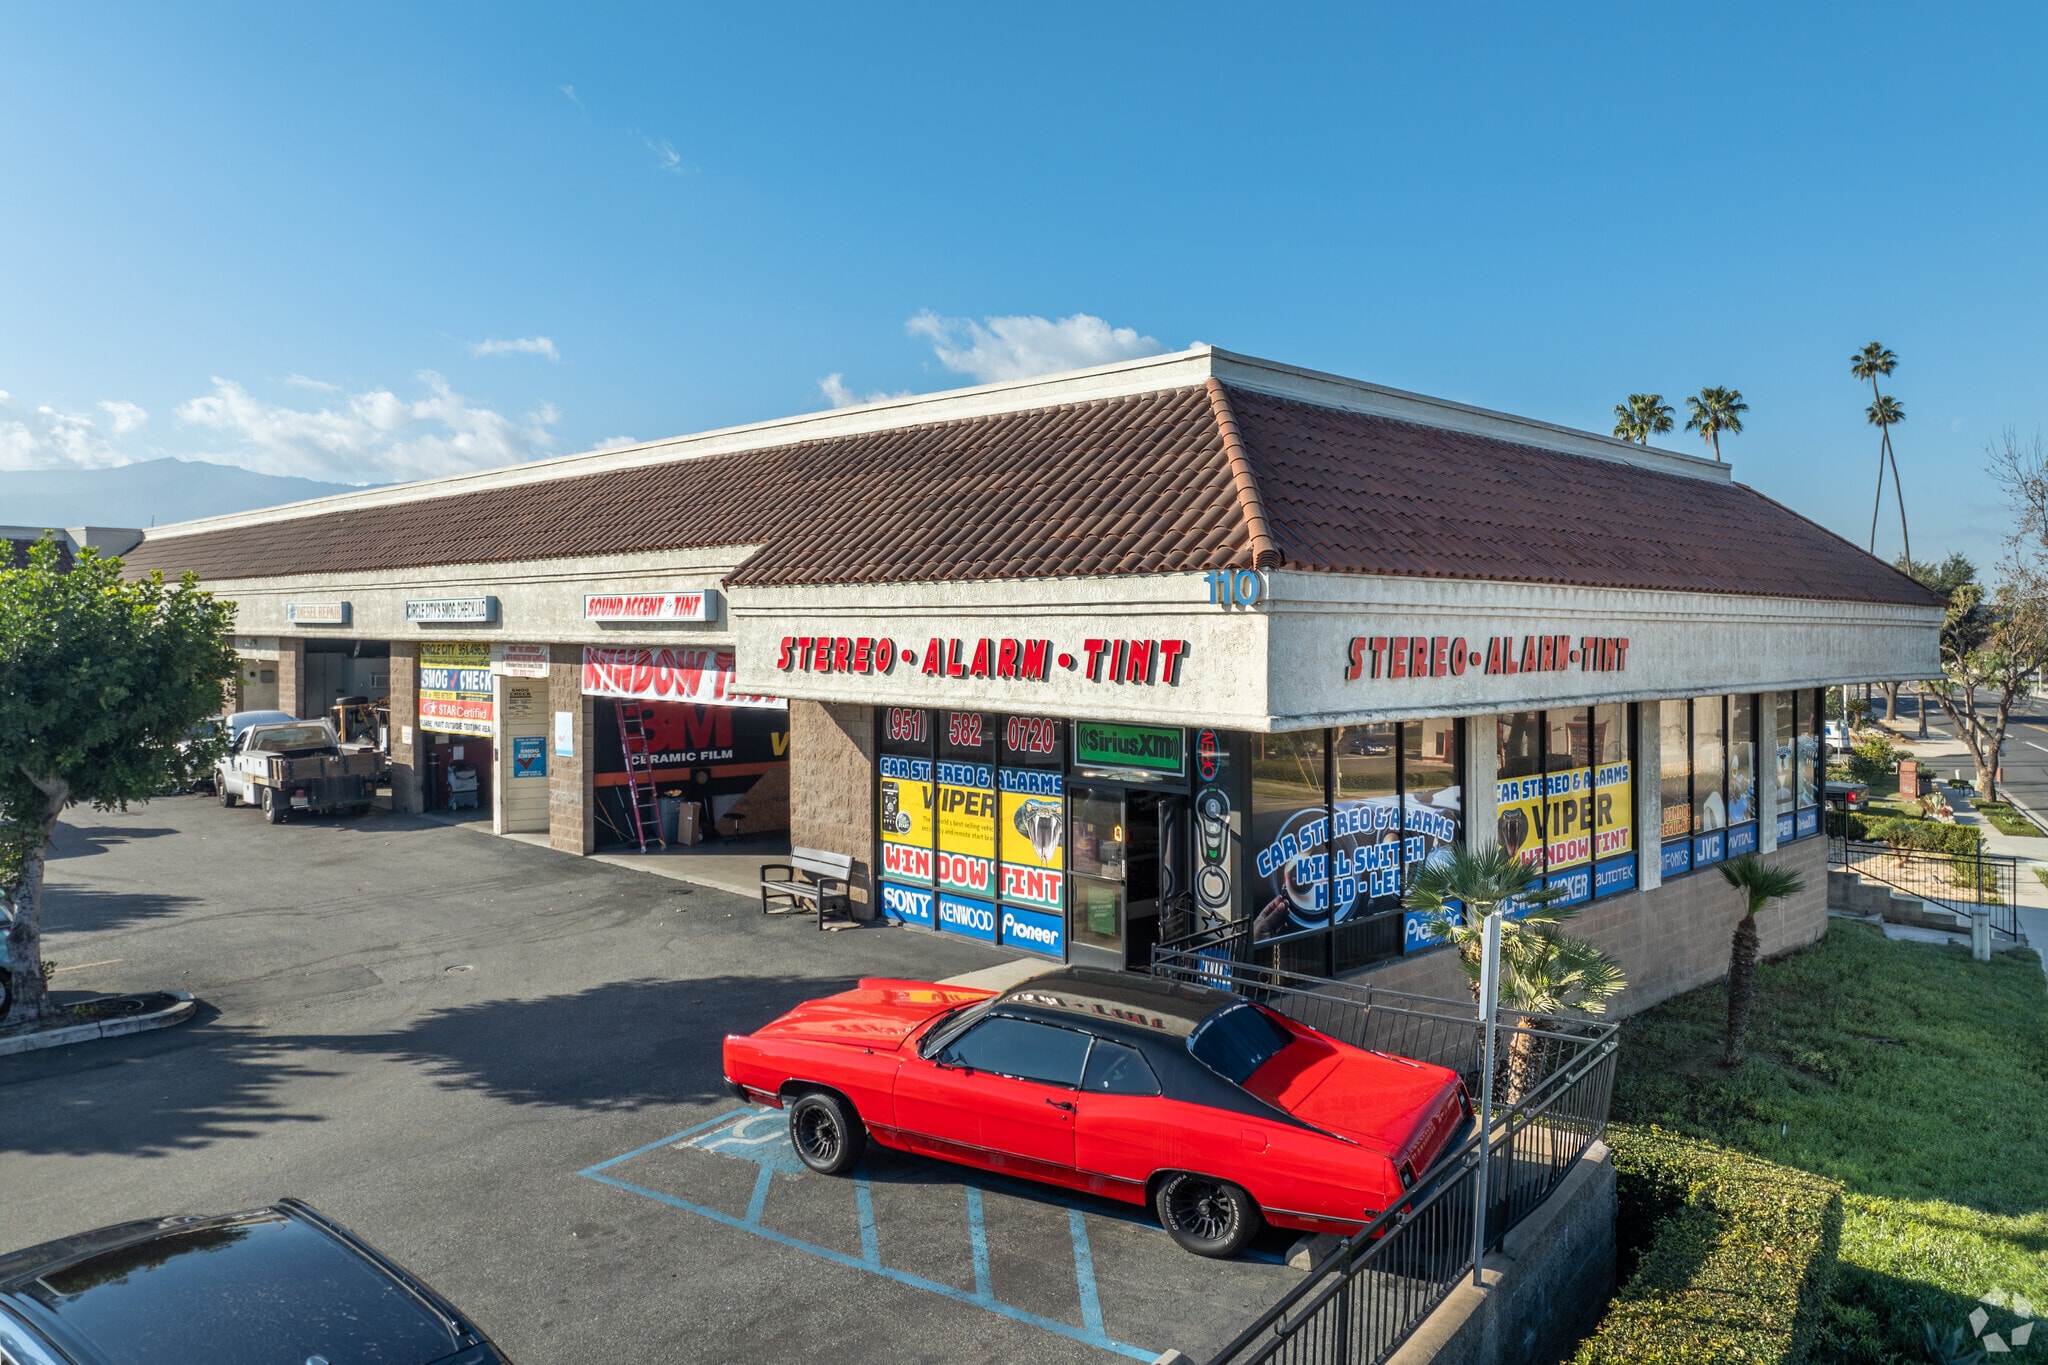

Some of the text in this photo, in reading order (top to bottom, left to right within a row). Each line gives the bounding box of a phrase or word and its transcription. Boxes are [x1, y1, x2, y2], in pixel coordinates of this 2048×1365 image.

[1204, 570, 1259, 606] 110
[297, 605, 341, 619] DIESEL REPAIR
[407, 602, 425, 619] CIRCLE
[441, 600, 456, 618] SMOG
[457, 600, 476, 618] CHECK
[587, 597, 623, 616] SOUND
[623, 596, 664, 616] ACCENT
[673, 596, 701, 616] TINT
[442, 644, 456, 656] CITY
[777, 636, 1185, 684] STEREO ALARM TINT
[1345, 635, 1629, 680] STEREO ALARM TINT
[421, 669, 492, 691] SMOG CHECK
[584, 647, 708, 697] WINDOW
[438, 703, 487, 719] STAR Certified
[886, 708, 1054, 753] (951) 582 0720
[631, 750, 733, 765] CERAMIC FILM
[880, 757, 1062, 795] CAR STEREO & ALARMS
[1521, 772, 1570, 801] STEREO
[1572, 771, 1581, 791] &
[922, 785, 995, 819] VIPER
[1531, 793, 1613, 840] VIPER
[1256, 833, 1298, 878] CAR
[1299, 806, 1372, 852] STEREO
[1374, 806, 1387, 828] &
[1697, 835, 1720, 862] JVC
[884, 842, 1062, 904] WINDOW TINT
[1296, 850, 1351, 886] KILL
[1314, 877, 1355, 911] HID
[1547, 873, 1588, 905] KICKER
[884, 887, 1059, 945] SONY KENWOOD Pioneer
[1165, 1174, 1188, 1231] COOPER COBRA
